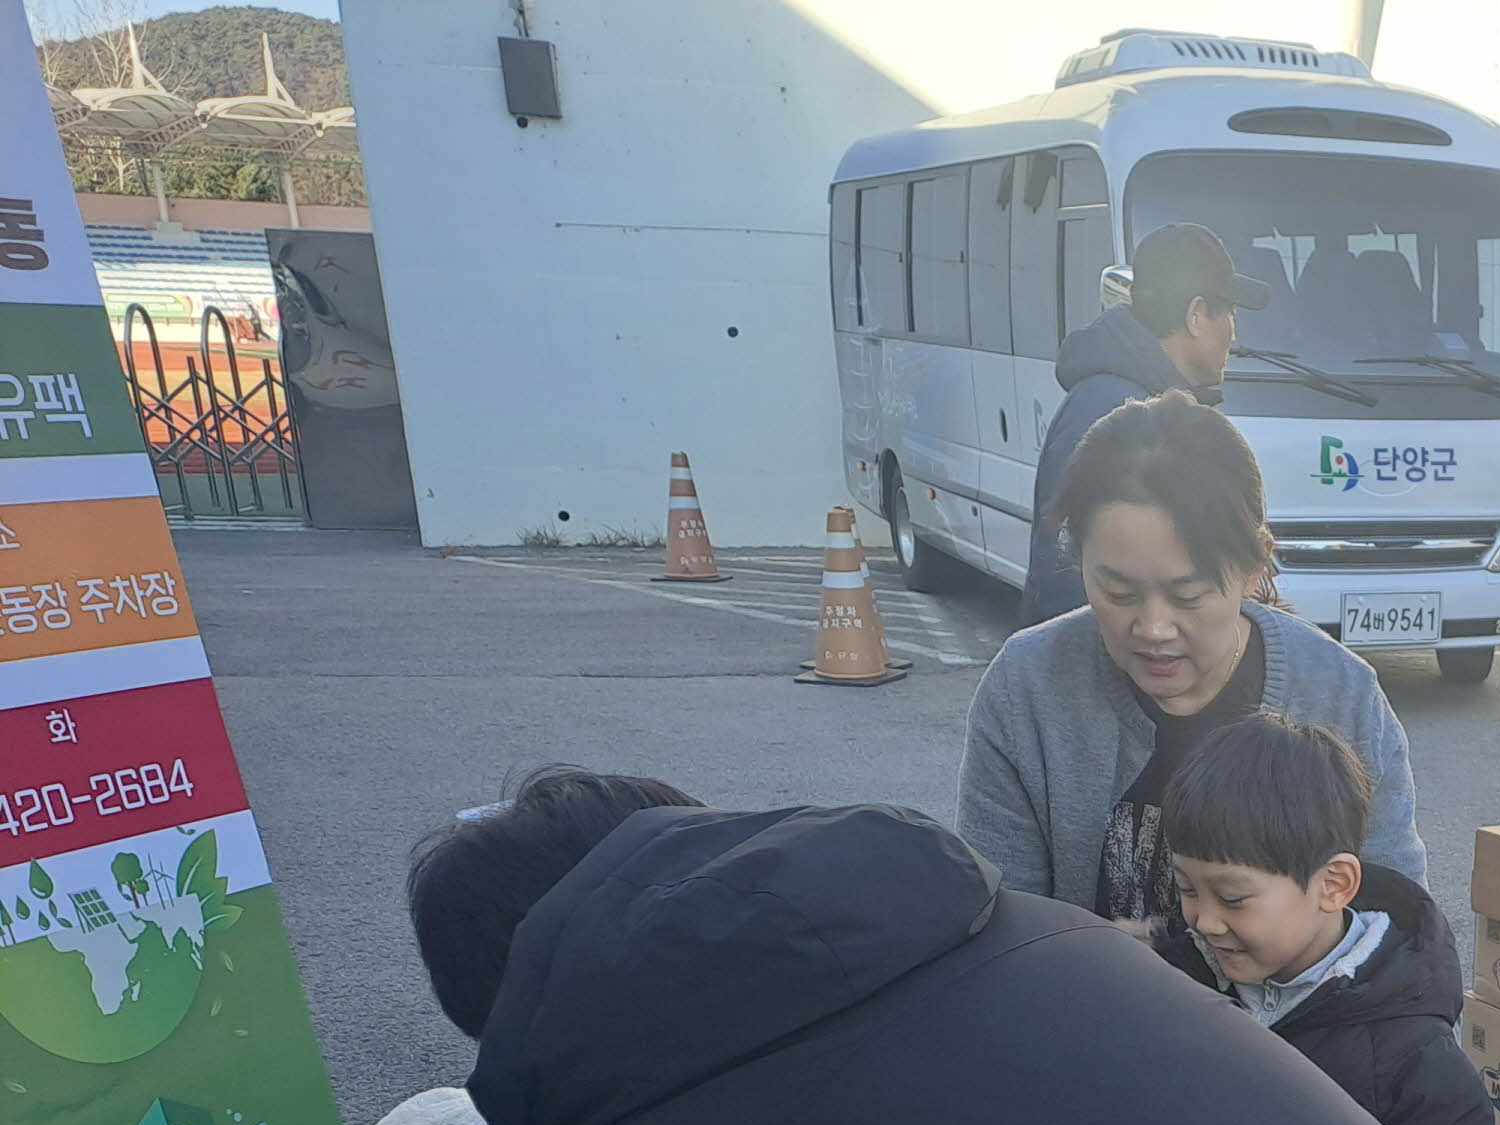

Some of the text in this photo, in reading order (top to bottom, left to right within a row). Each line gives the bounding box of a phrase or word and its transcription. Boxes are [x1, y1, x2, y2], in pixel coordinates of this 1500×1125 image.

[0, 373, 93, 440] 유팩
[1373, 446, 1458, 482] 단양군
[0, 571, 178, 636] 동장 주차장
[1347, 607, 1436, 632] 74버9541
[45, 708, 77, 743] 화
[0, 758, 194, 836] 420-2684
